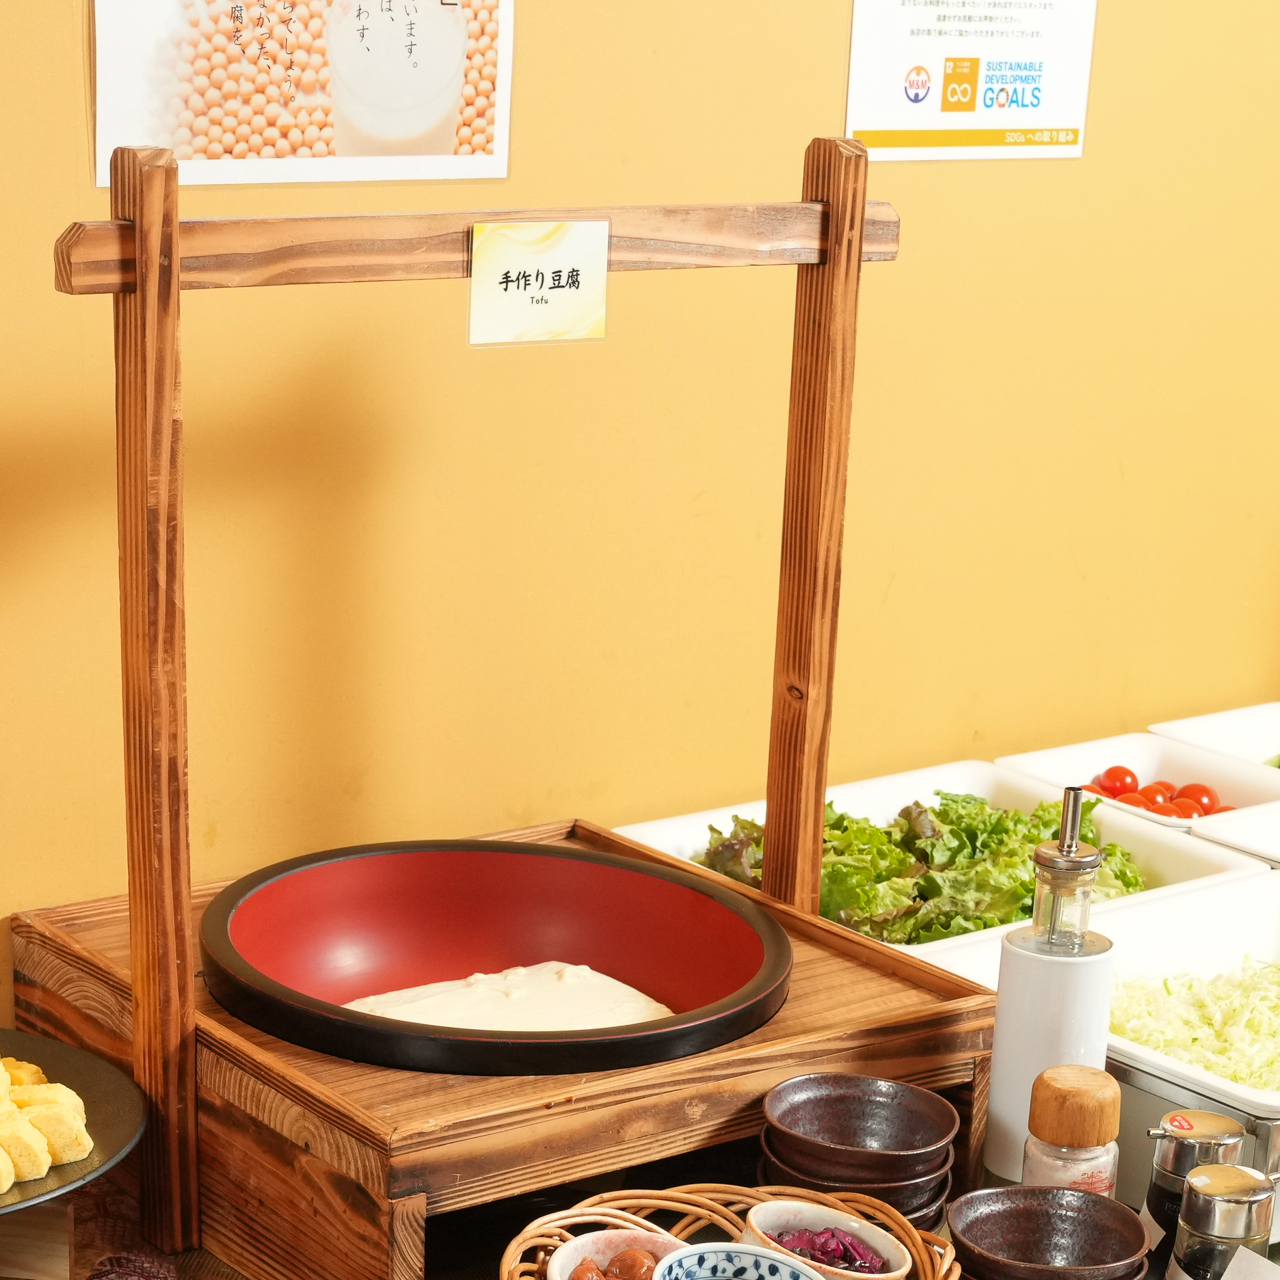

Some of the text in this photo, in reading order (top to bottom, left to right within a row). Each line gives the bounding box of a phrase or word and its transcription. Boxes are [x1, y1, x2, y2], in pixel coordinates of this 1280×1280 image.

[986, 61, 1043, 72] SUSTAINABLE
[908, 79, 927, 90] M&M
[985, 74, 1042, 85] DEVELOPMENT
[983, 87, 1041, 109] GOALS
[1005, 132, 1025, 143] SDGs
[498, 268, 581, 292] 手作り豆腐
[530, 295, 549, 305] Tofu
